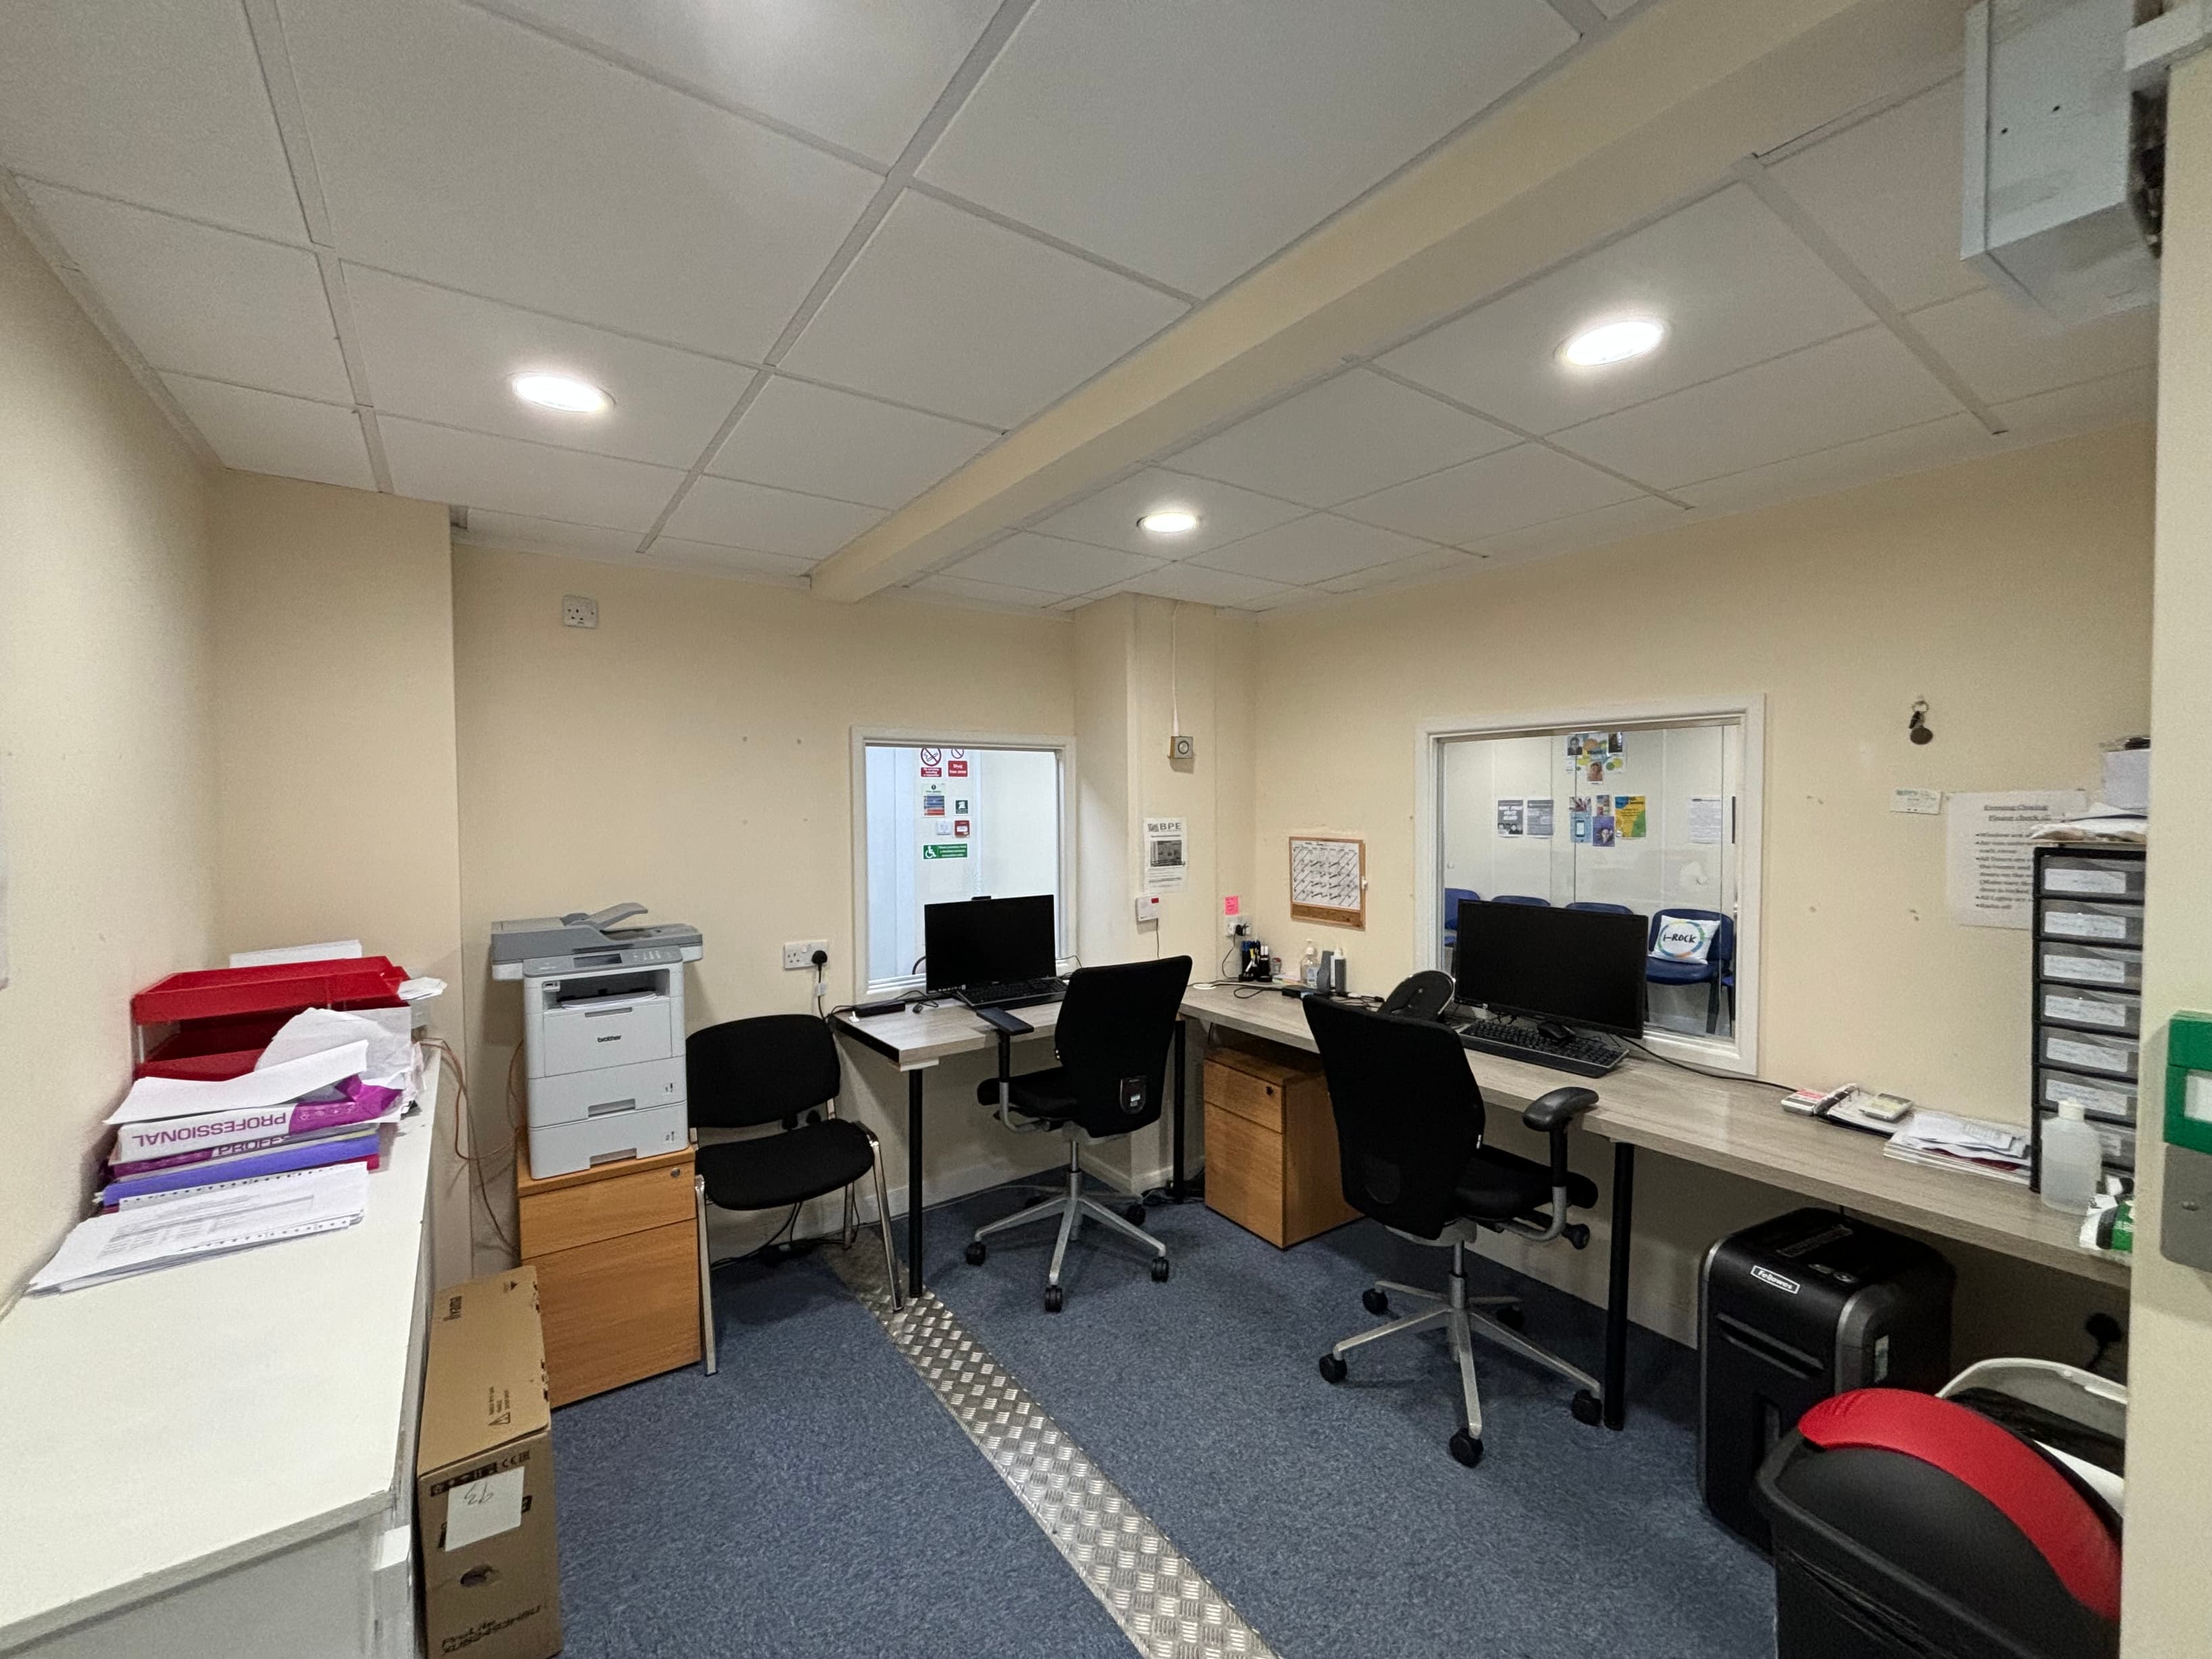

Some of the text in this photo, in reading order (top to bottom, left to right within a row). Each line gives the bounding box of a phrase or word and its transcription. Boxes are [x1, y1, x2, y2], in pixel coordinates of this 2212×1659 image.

[1159, 822, 1182, 830] BPE
[597, 1035, 622, 1043] brother
[132, 1112, 287, 1147] PROFESSIONAL
[1757, 1269, 1793, 1290] Fellowes
